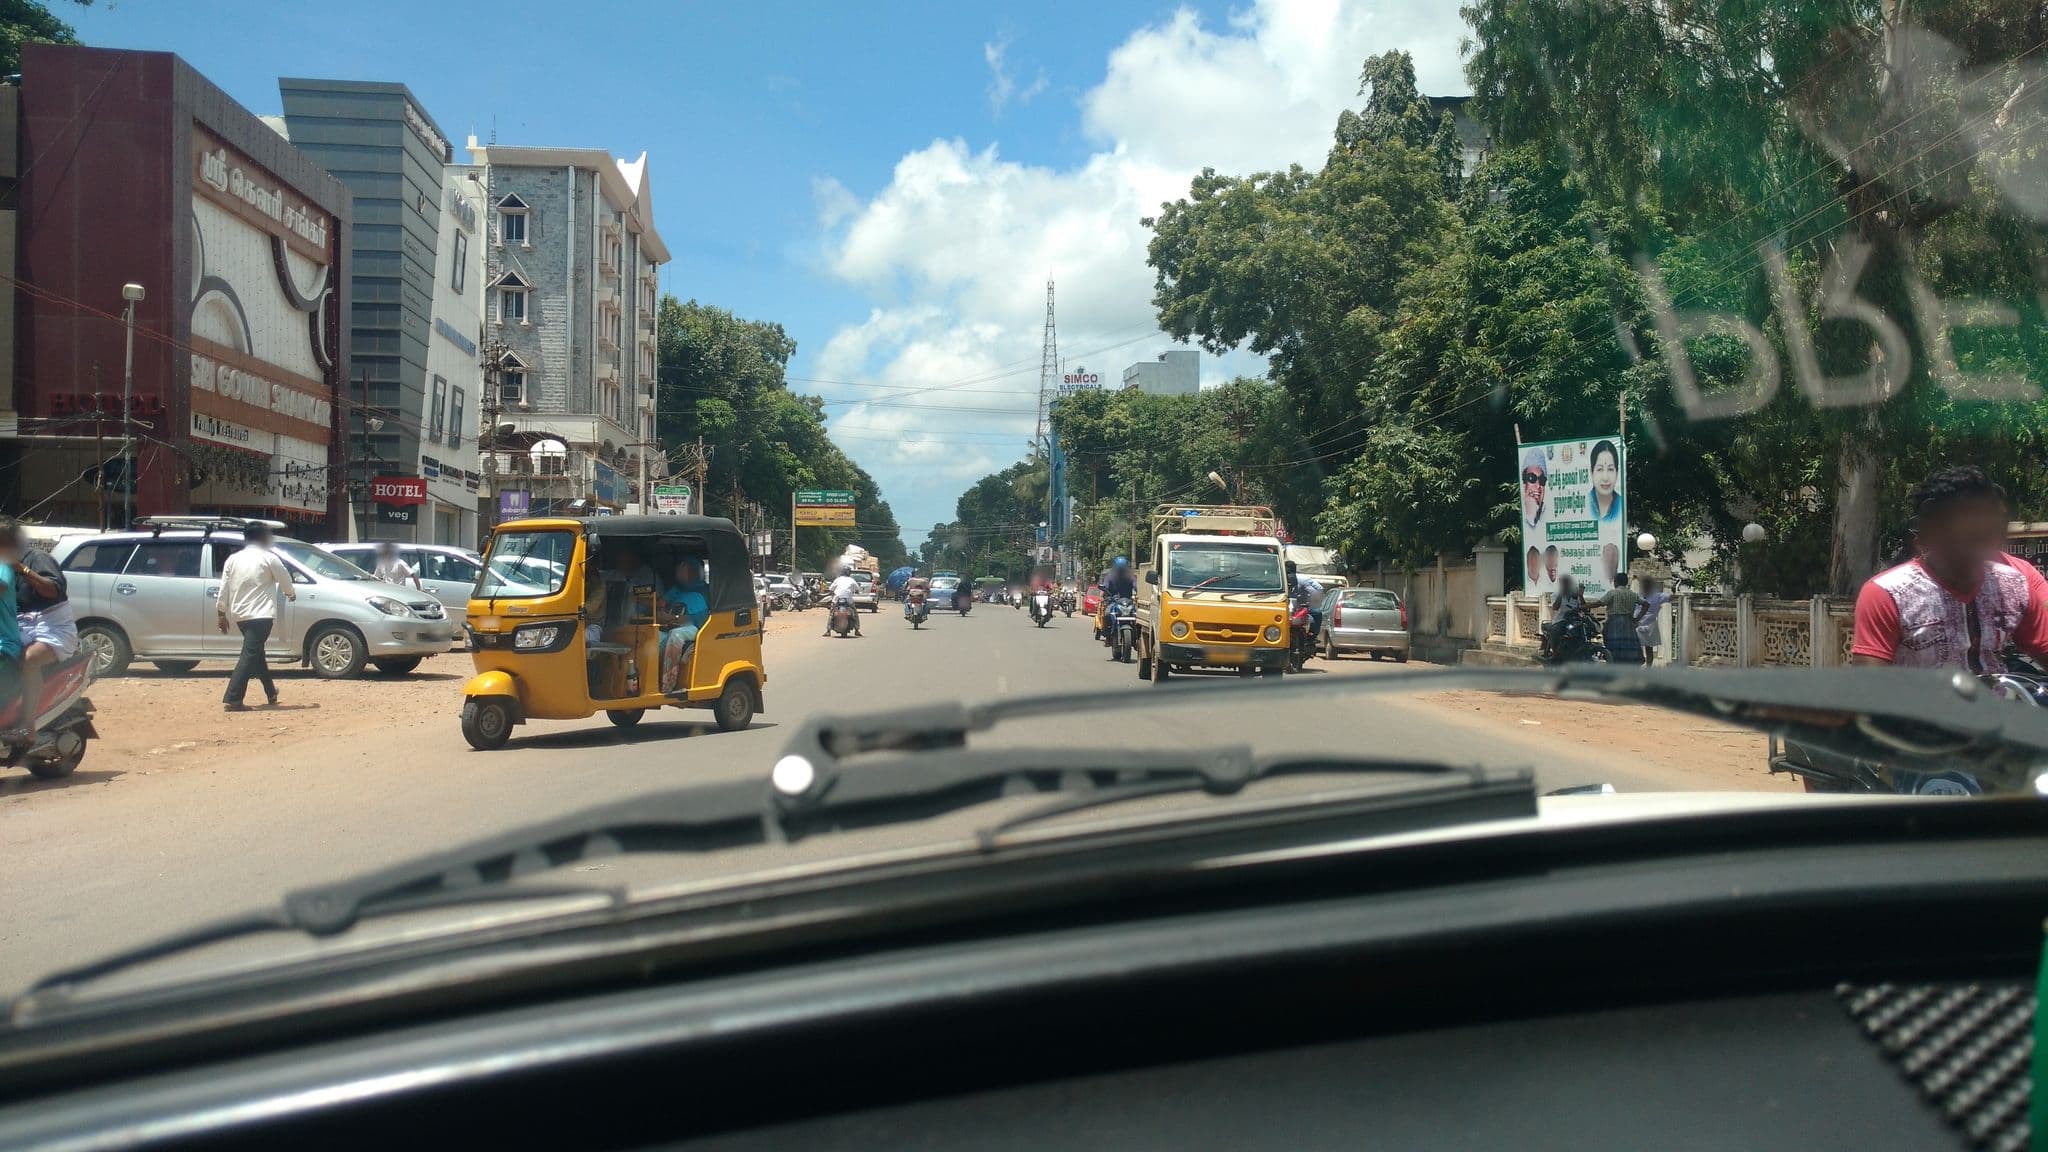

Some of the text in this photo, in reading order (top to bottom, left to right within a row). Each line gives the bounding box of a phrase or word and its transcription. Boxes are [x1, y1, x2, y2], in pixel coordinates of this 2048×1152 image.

[283, 205, 327, 249] சங்கர்
[1064, 374, 1098, 384] SIMCO
[374, 484, 423, 498] HOTEL
[387, 511, 409, 521] veg
